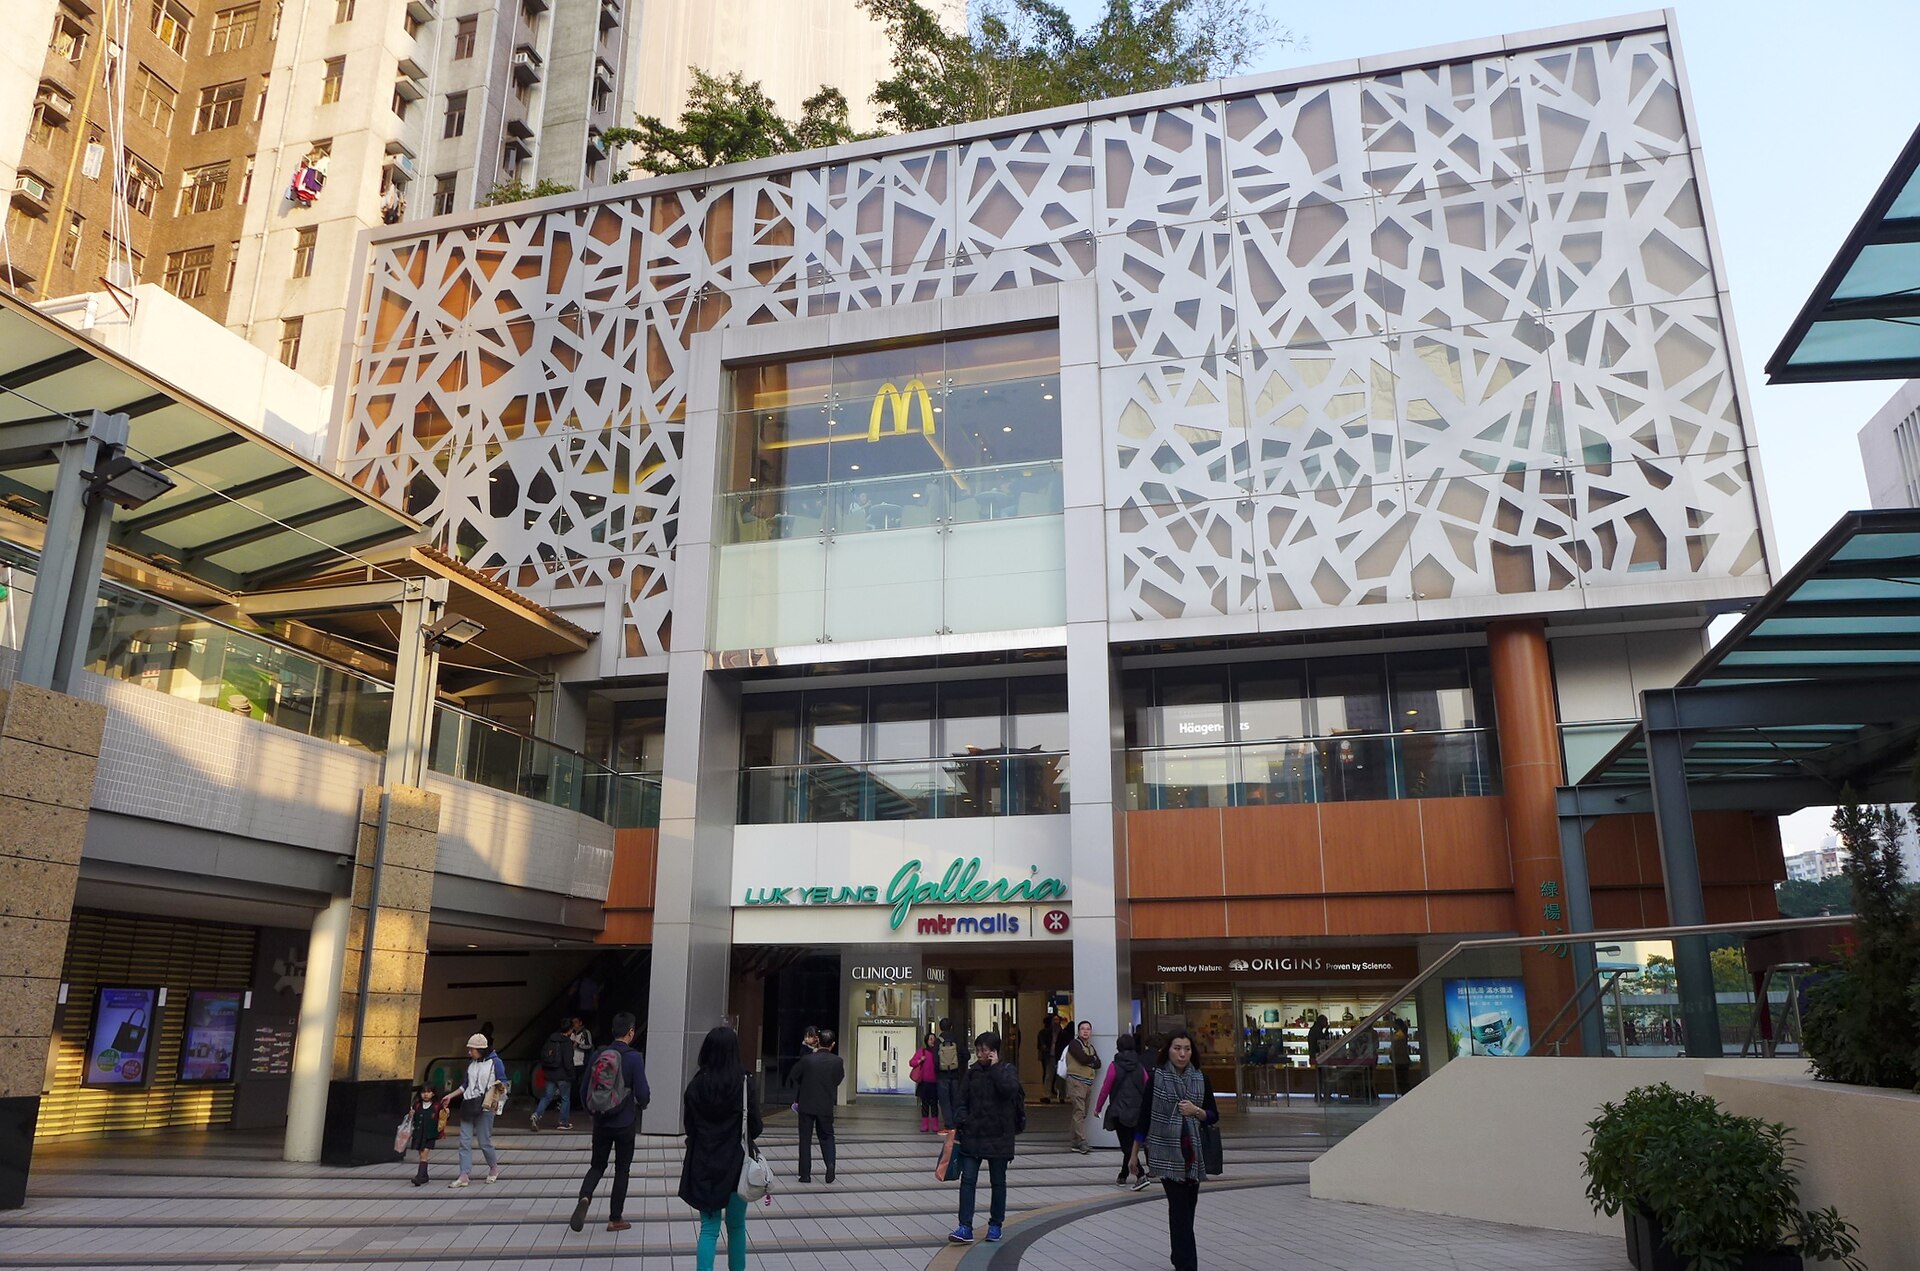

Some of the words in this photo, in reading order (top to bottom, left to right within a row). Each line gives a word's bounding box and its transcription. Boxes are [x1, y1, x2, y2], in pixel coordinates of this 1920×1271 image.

[1179, 722, 1250, 735] Häagen-zs
[745, 886, 792, 904] LUK
[793, 886, 879, 904] YEUNG
[886, 856, 1069, 930] Galleria
[917, 912, 1020, 935] mtrmalls
[1157, 965, 1187, 973] Powered
[1188, 964, 1198, 973] by
[1251, 958, 1322, 970] ORIGINS
[1325, 963, 1351, 971] Proven
[1352, 962, 1361, 971] by
[851, 966, 913, 981] CLINIQUE
[926, 967, 945, 982] CLINIQUE
